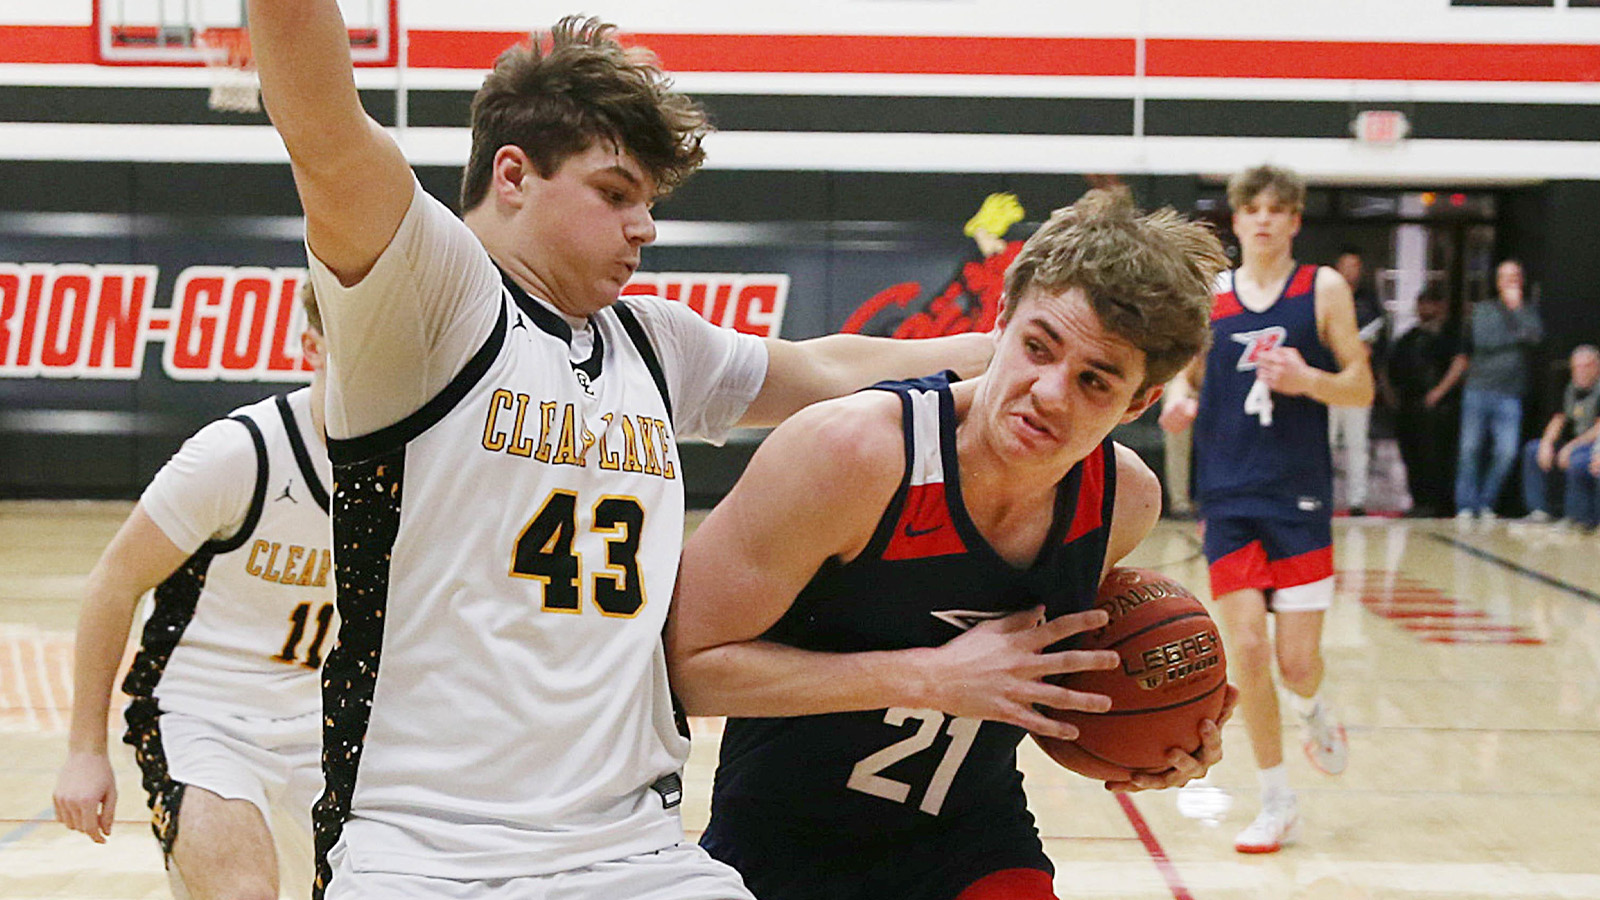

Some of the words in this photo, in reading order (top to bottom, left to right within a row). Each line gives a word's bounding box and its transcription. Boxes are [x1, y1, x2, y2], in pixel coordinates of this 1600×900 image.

[1244, 378, 1273, 426] 4
[508, 487, 648, 618] 43
[270, 601, 335, 671] 11
[846, 706, 985, 816] 21
